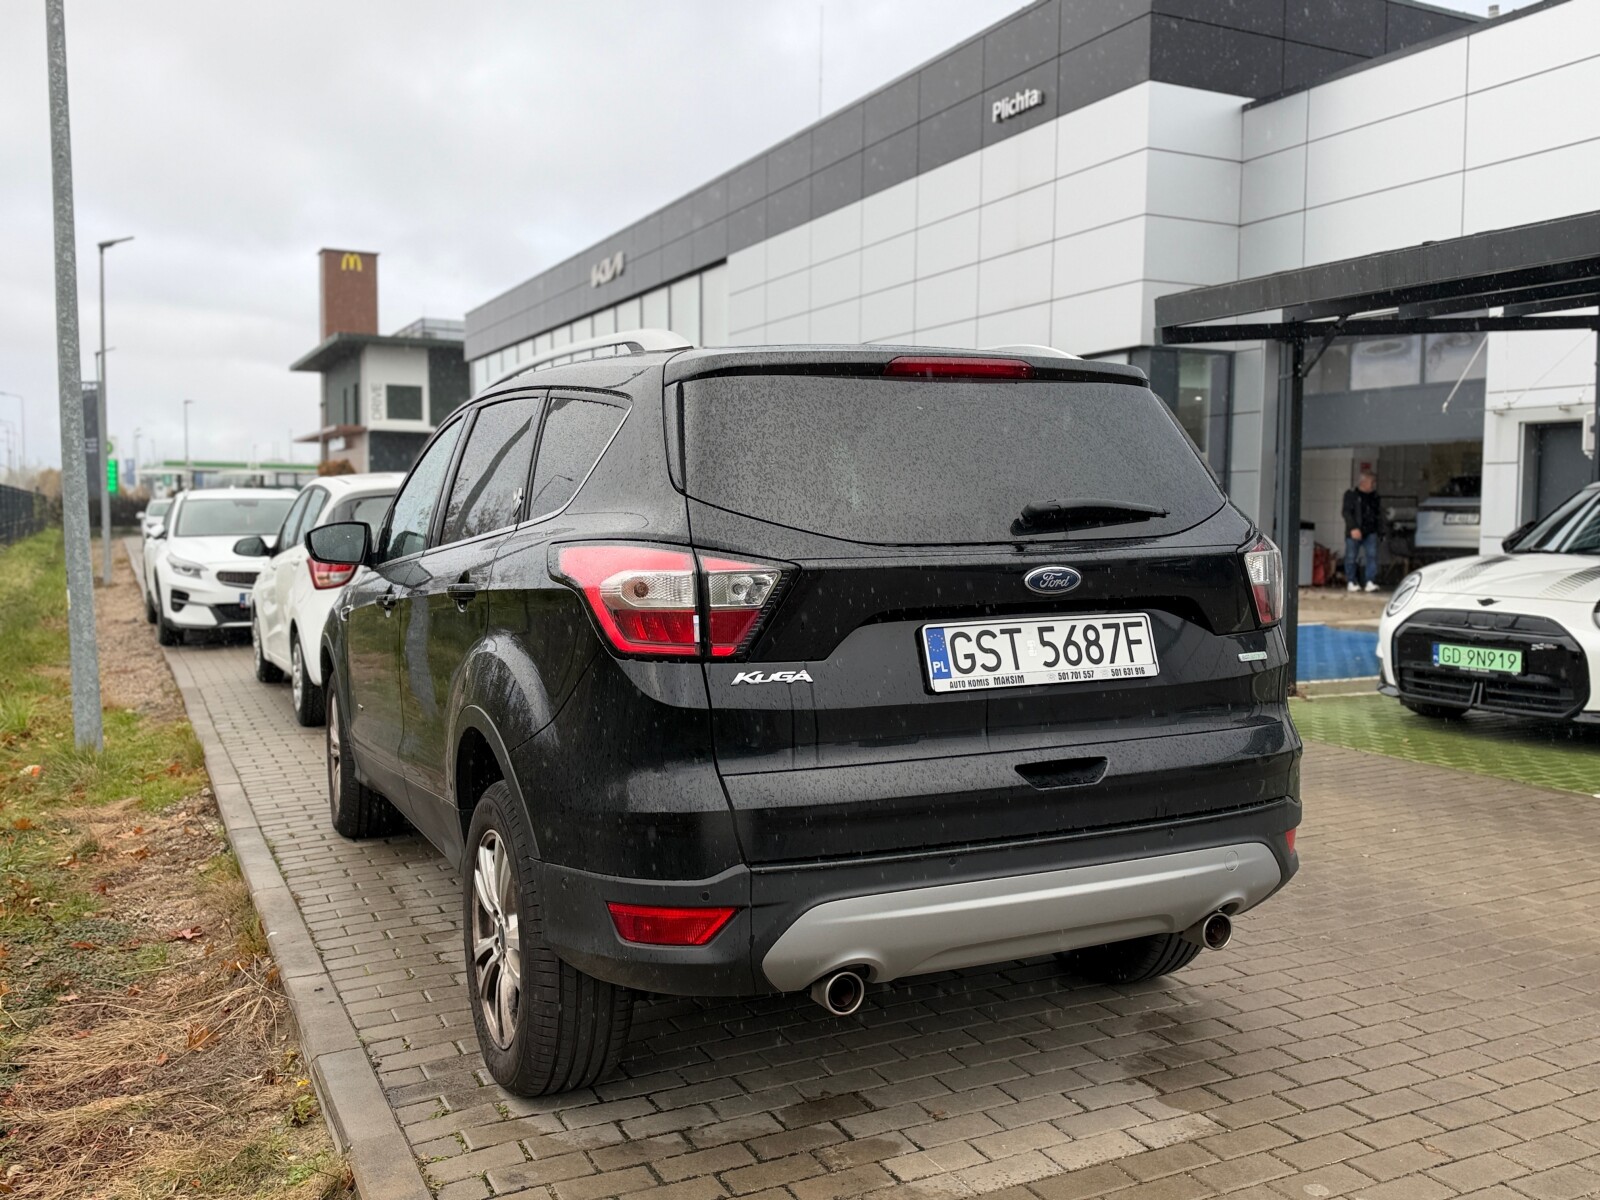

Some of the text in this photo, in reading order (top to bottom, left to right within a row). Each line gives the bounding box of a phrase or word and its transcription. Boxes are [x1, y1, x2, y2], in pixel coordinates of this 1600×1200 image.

[992, 88, 1042, 123] Plichta
[370, 382, 383, 421] DRIVE
[1040, 572, 1070, 588] Ford
[949, 621, 1143, 675] GST 5687F
[1442, 646, 1461, 664] GD
[1467, 649, 1517, 669] 9N919
[932, 660, 949, 673] PL
[1111, 667, 1145, 677] 501 631 916
[730, 669, 814, 686] KUGA
[949, 674, 1025, 689] AUTO KOMIS MAKSIM
[1057, 670, 1094, 680] 501 701 557
